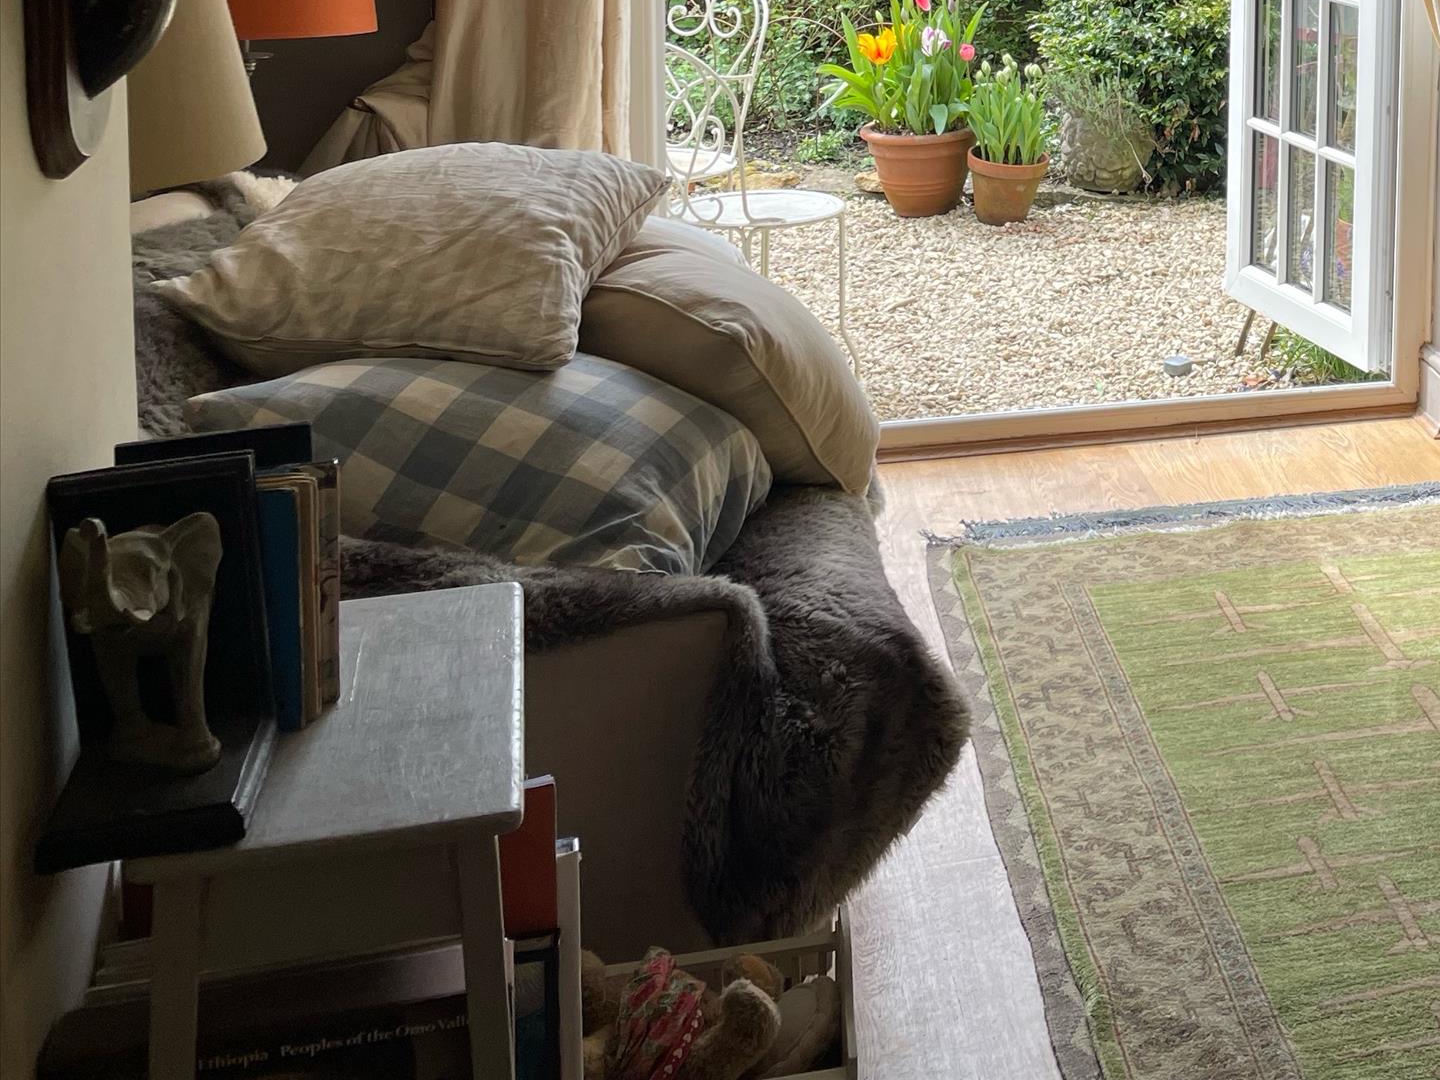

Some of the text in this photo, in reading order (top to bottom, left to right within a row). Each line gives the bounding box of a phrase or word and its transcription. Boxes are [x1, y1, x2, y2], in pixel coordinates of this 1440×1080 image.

[198, 1050, 269, 1071] Ethiopia
[280, 1036, 343, 1058] Peoples
[367, 1027, 394, 1042] the
[395, 1023, 436, 1038] Omo
